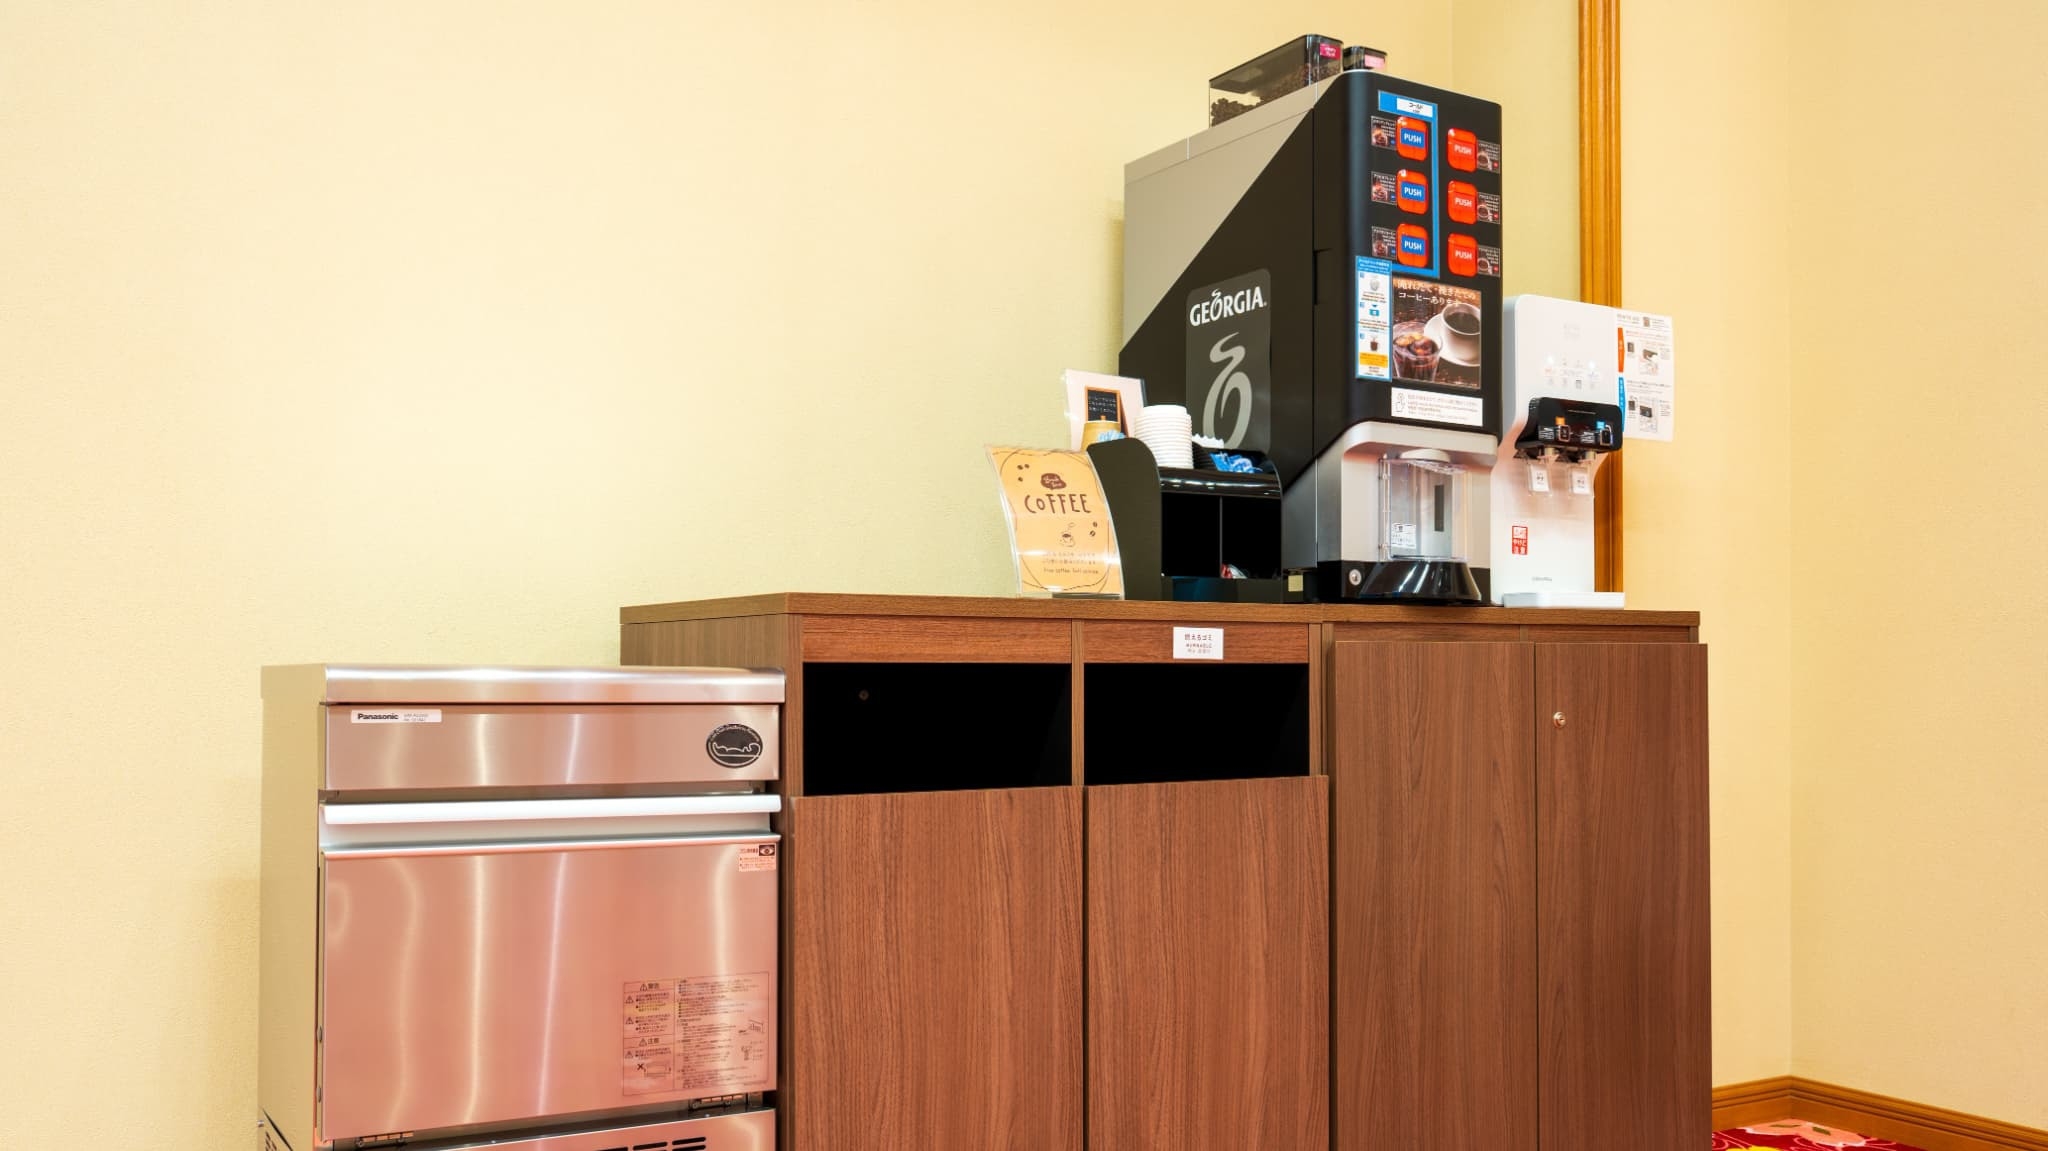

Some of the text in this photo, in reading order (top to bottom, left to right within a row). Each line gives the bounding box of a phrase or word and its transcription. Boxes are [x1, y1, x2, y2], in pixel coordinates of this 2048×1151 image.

[1403, 133, 1422, 145] PUSH
[1453, 144, 1472, 155] PUSH
[1404, 186, 1422, 198] PUSH
[1454, 197, 1473, 208] PUSH
[1404, 240, 1422, 252] PUSH
[1455, 250, 1473, 260] PUSH
[1189, 286, 1265, 327] GEORGIA
[357, 712, 399, 720] Panasonic
